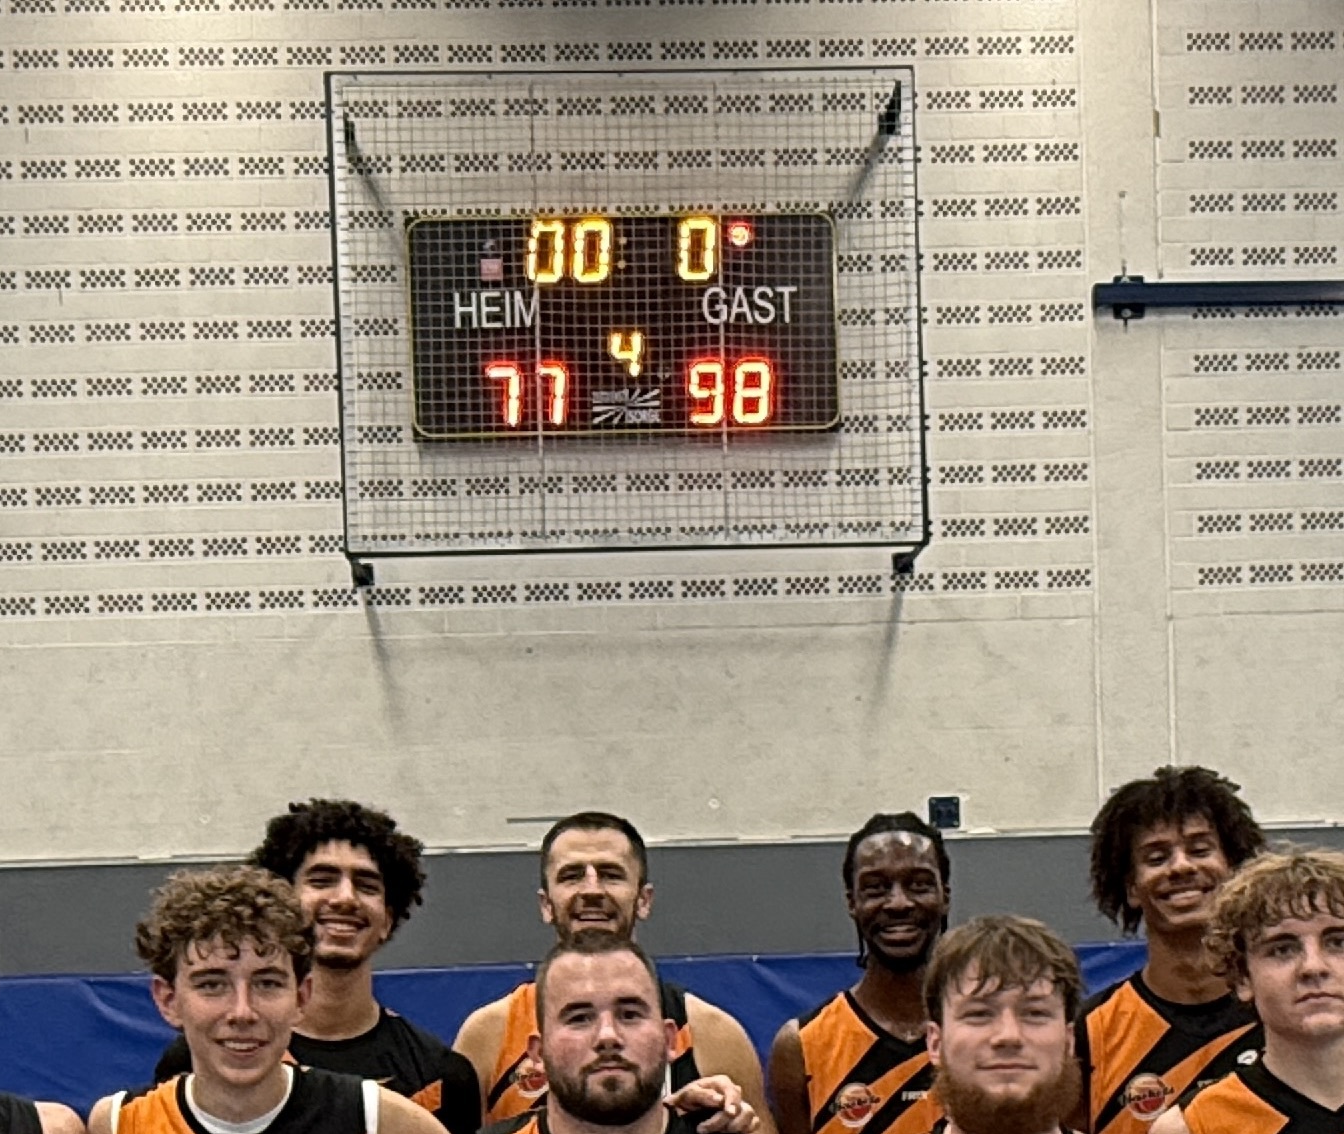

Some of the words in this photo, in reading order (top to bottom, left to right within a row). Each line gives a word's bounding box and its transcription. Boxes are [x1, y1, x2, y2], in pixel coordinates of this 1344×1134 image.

[455, 292, 540, 329] HEIM
[701, 286, 798, 325] GAST
[610, 331, 644, 378] 4
[485, 362, 567, 427] 77
[687, 360, 773, 425] 98
